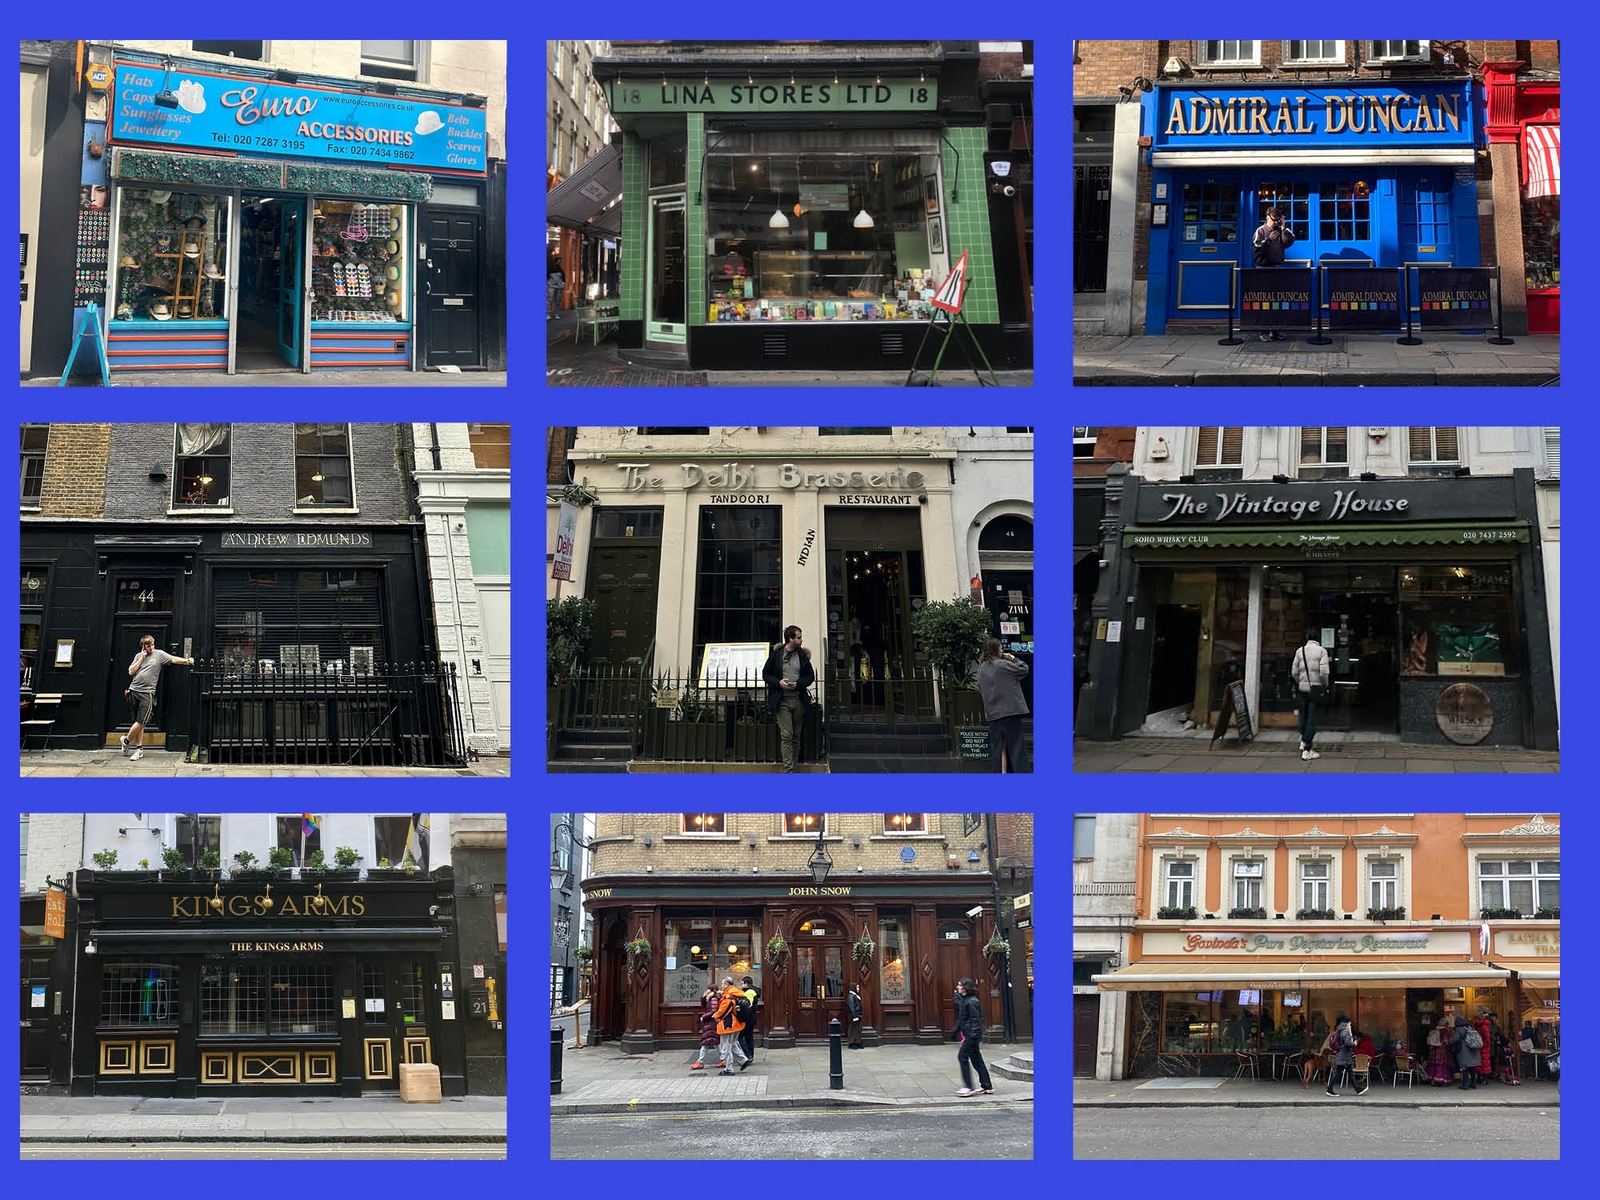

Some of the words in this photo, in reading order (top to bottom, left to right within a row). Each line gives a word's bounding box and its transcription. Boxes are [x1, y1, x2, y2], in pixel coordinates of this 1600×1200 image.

[92, 73, 107, 81] ADT
[122, 73, 154, 87] Hats
[122, 88, 155, 104] Caps
[622, 89, 642, 105] 18
[661, 85, 715, 105] LINA
[730, 85, 831, 105] STORES
[846, 84, 892, 104] LTD
[909, 88, 929, 103] 18
[220, 86, 318, 126] Euro
[322, 95, 415, 112] www.euroaccessories.co.uk
[120, 105, 193, 124] Sunglasses
[447, 113, 470, 125] Belts
[1165, 96, 1314, 135] ADMIRAL
[1324, 93, 1462, 134] DUNCAN
[119, 121, 182, 141] Jewellery
[297, 120, 414, 147] ACCESSORIES
[447, 127, 483, 140] Buckles
[211, 132, 231, 143] Tel:
[233, 134, 252, 145] 020
[255, 137, 278, 148] 7287
[281, 139, 305, 150] 3195
[446, 139, 482, 153] Scarves
[327, 143, 348, 154] Fax:
[350, 145, 367, 156] 020
[370, 147, 391, 158] 7434
[393, 149, 415, 160] 9862
[446, 153, 477, 165] Gloves
[448, 239, 457, 249] 33
[1243, 292, 1276, 301] ADMIRAL
[1277, 292, 1309, 301] DUNCAN
[1331, 292, 1364, 301] ADMIRAL
[1365, 292, 1397, 301] DUNCAN
[1422, 291, 1456, 301] ADMIRAL
[1457, 290, 1488, 300] DUNCAN
[616, 462, 662, 491] The
[680, 462, 755, 491] Delhi
[777, 462, 927, 490] Brasserie
[710, 494, 770, 504] TANDOORI
[838, 494, 912, 505] RESTAURANT
[1158, 493, 1208, 521] The
[1215, 492, 1321, 521] Vintage
[1327, 489, 1409, 521] House
[224, 533, 291, 545] ANDREW
[296, 533, 370, 545] EDMUNDS
[1188, 535, 1209, 543] CLUB
[796, 528, 817, 567] INDIAN
[138, 589, 155, 604] 44
[1008, 605, 1029, 614] ZIMA
[590, 887, 613, 899] SNOW
[788, 887, 818, 897] JOHN
[820, 886, 851, 896] SNOW
[171, 895, 267, 917] KINGS
[278, 895, 366, 916] ARMS
[47, 913, 65, 927] Roll
[1182, 934, 1249, 953] Govinda's
[1247, 934, 1285, 953] Pure
[1289, 934, 1357, 954] Vegetarian
[1352, 934, 1429, 953] Restaurant
[1508, 933, 1549, 942] RADHA
[230, 942, 253, 951] THE
[255, 942, 290, 951] KINGS
[292, 942, 324, 951] ARMS
[473, 1002, 487, 1014] 21
